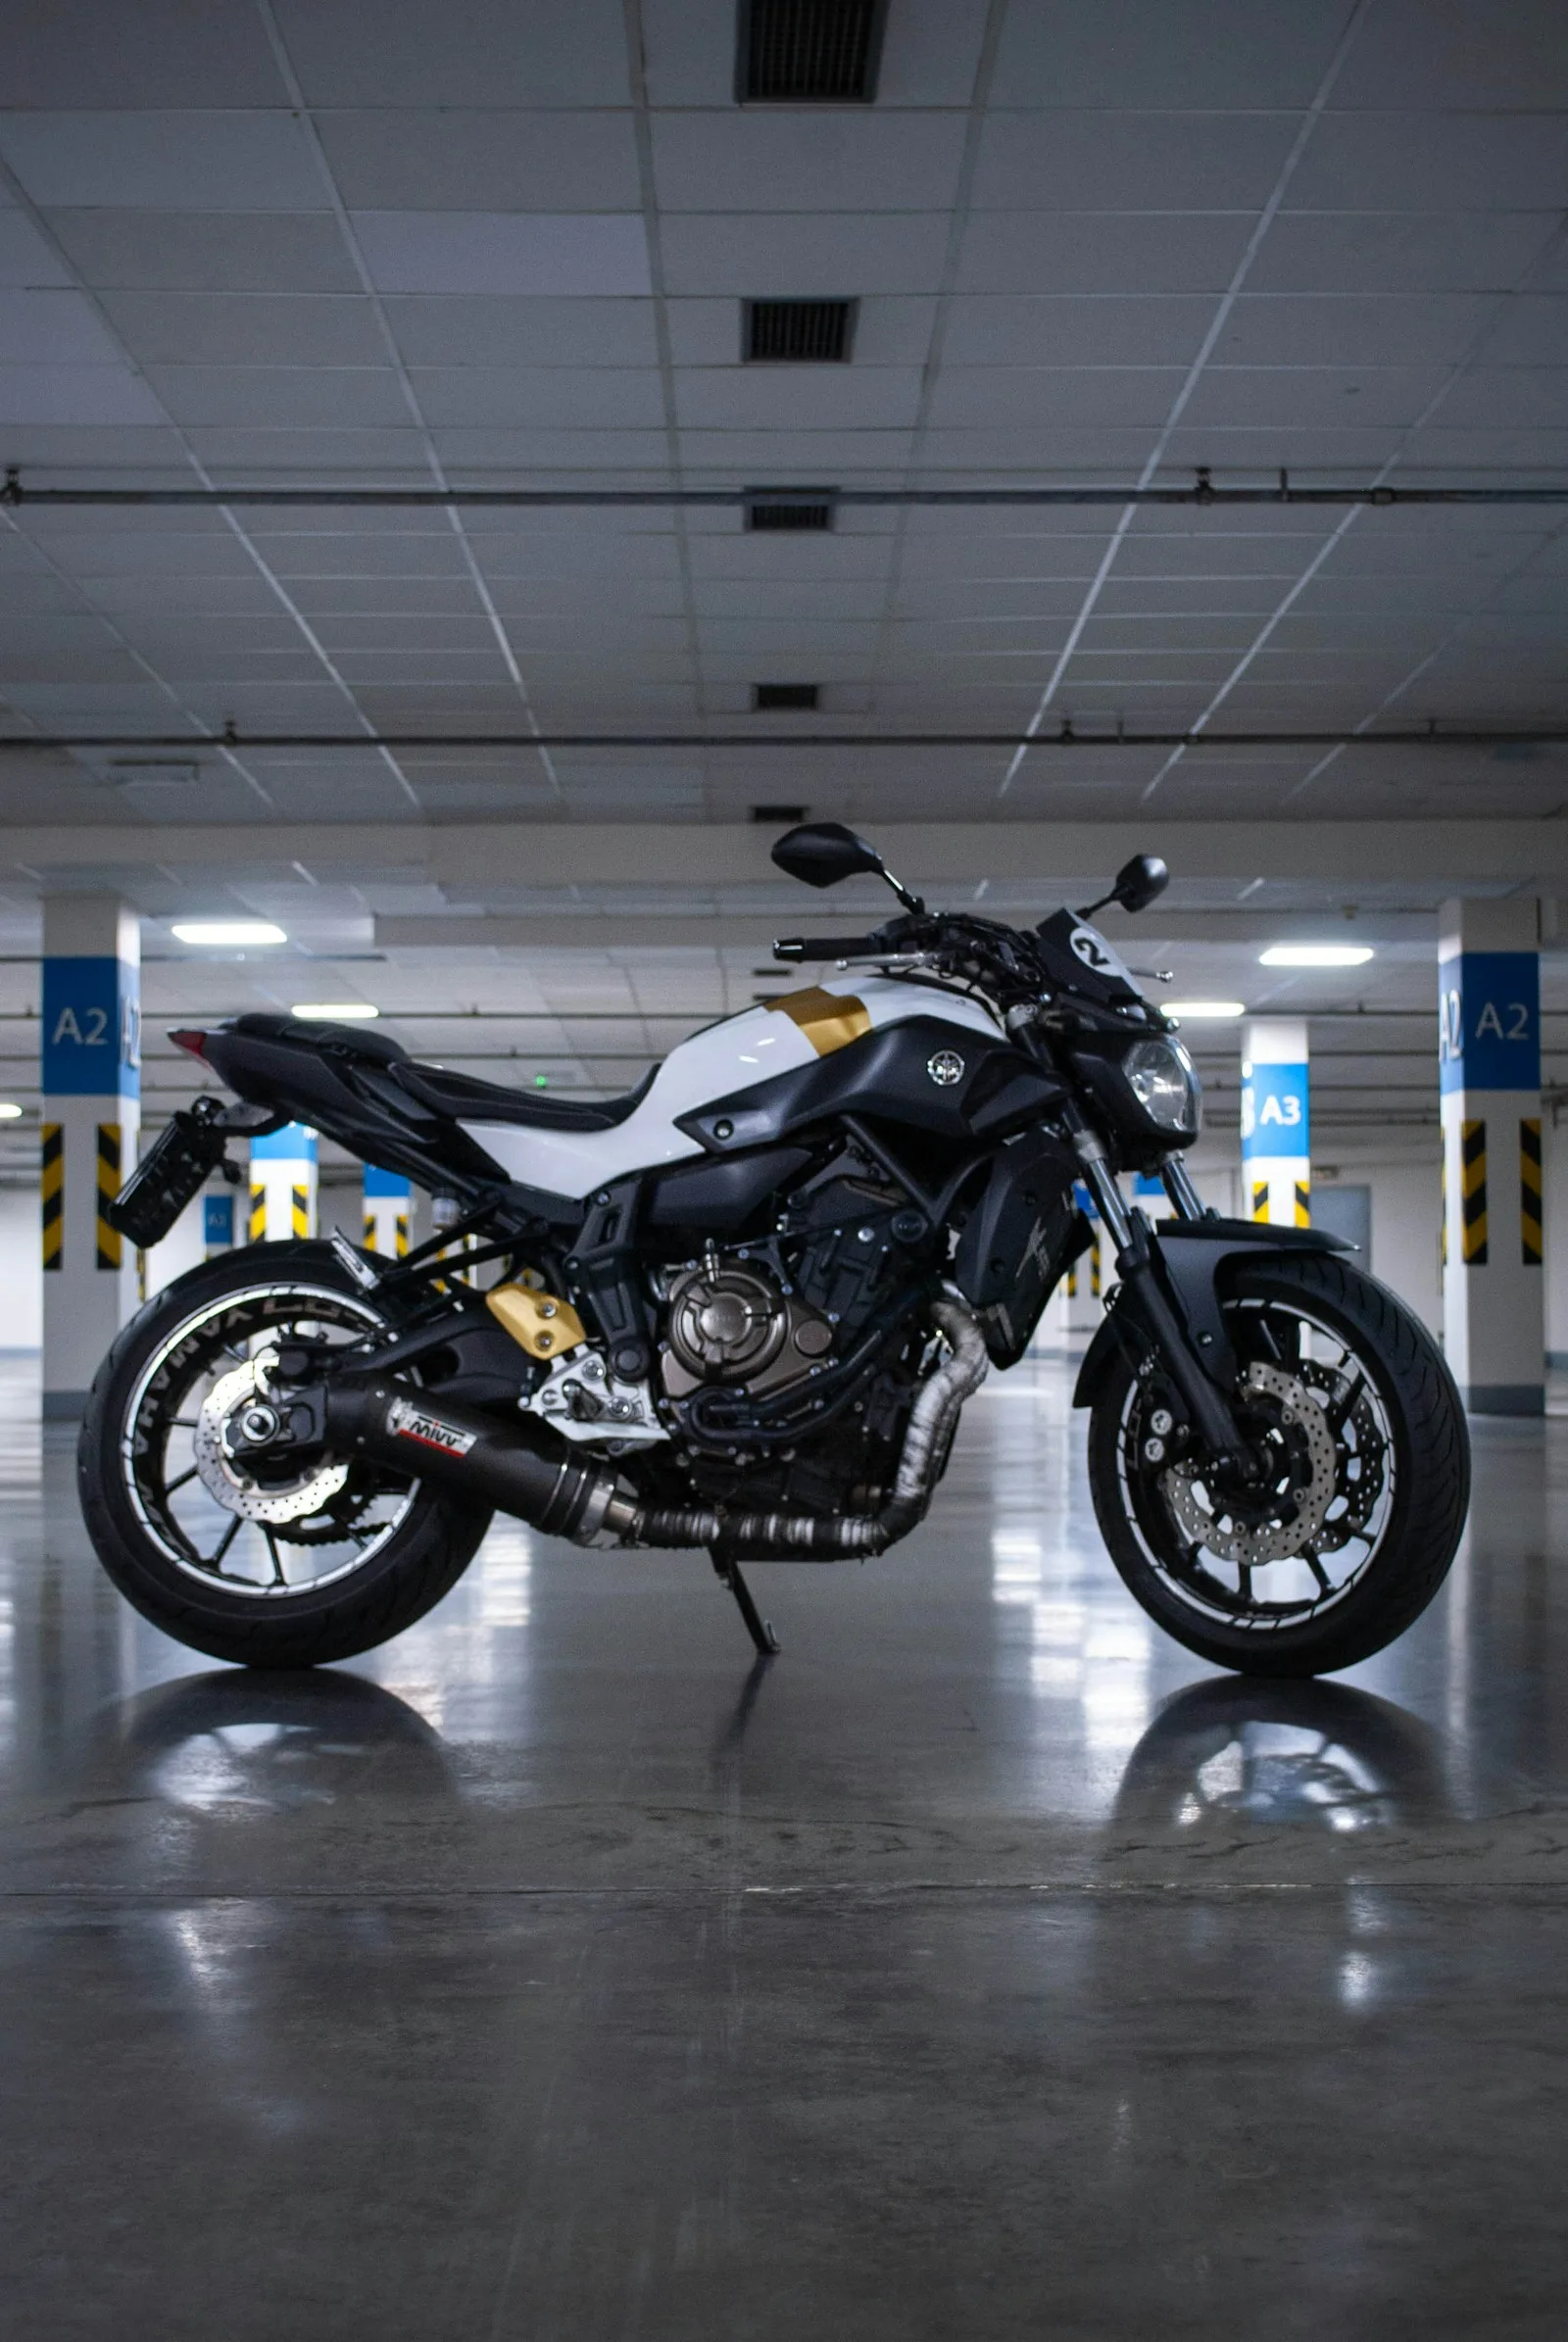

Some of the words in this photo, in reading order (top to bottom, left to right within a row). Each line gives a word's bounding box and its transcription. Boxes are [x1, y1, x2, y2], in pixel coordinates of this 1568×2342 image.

[1074, 938, 1111, 967] 2
[52, 1006, 109, 1046] A2
[1475, 1001, 1530, 1040] A2
[1260, 1094, 1301, 1126] A3
[133, 1307, 253, 1455] YAMAHA
